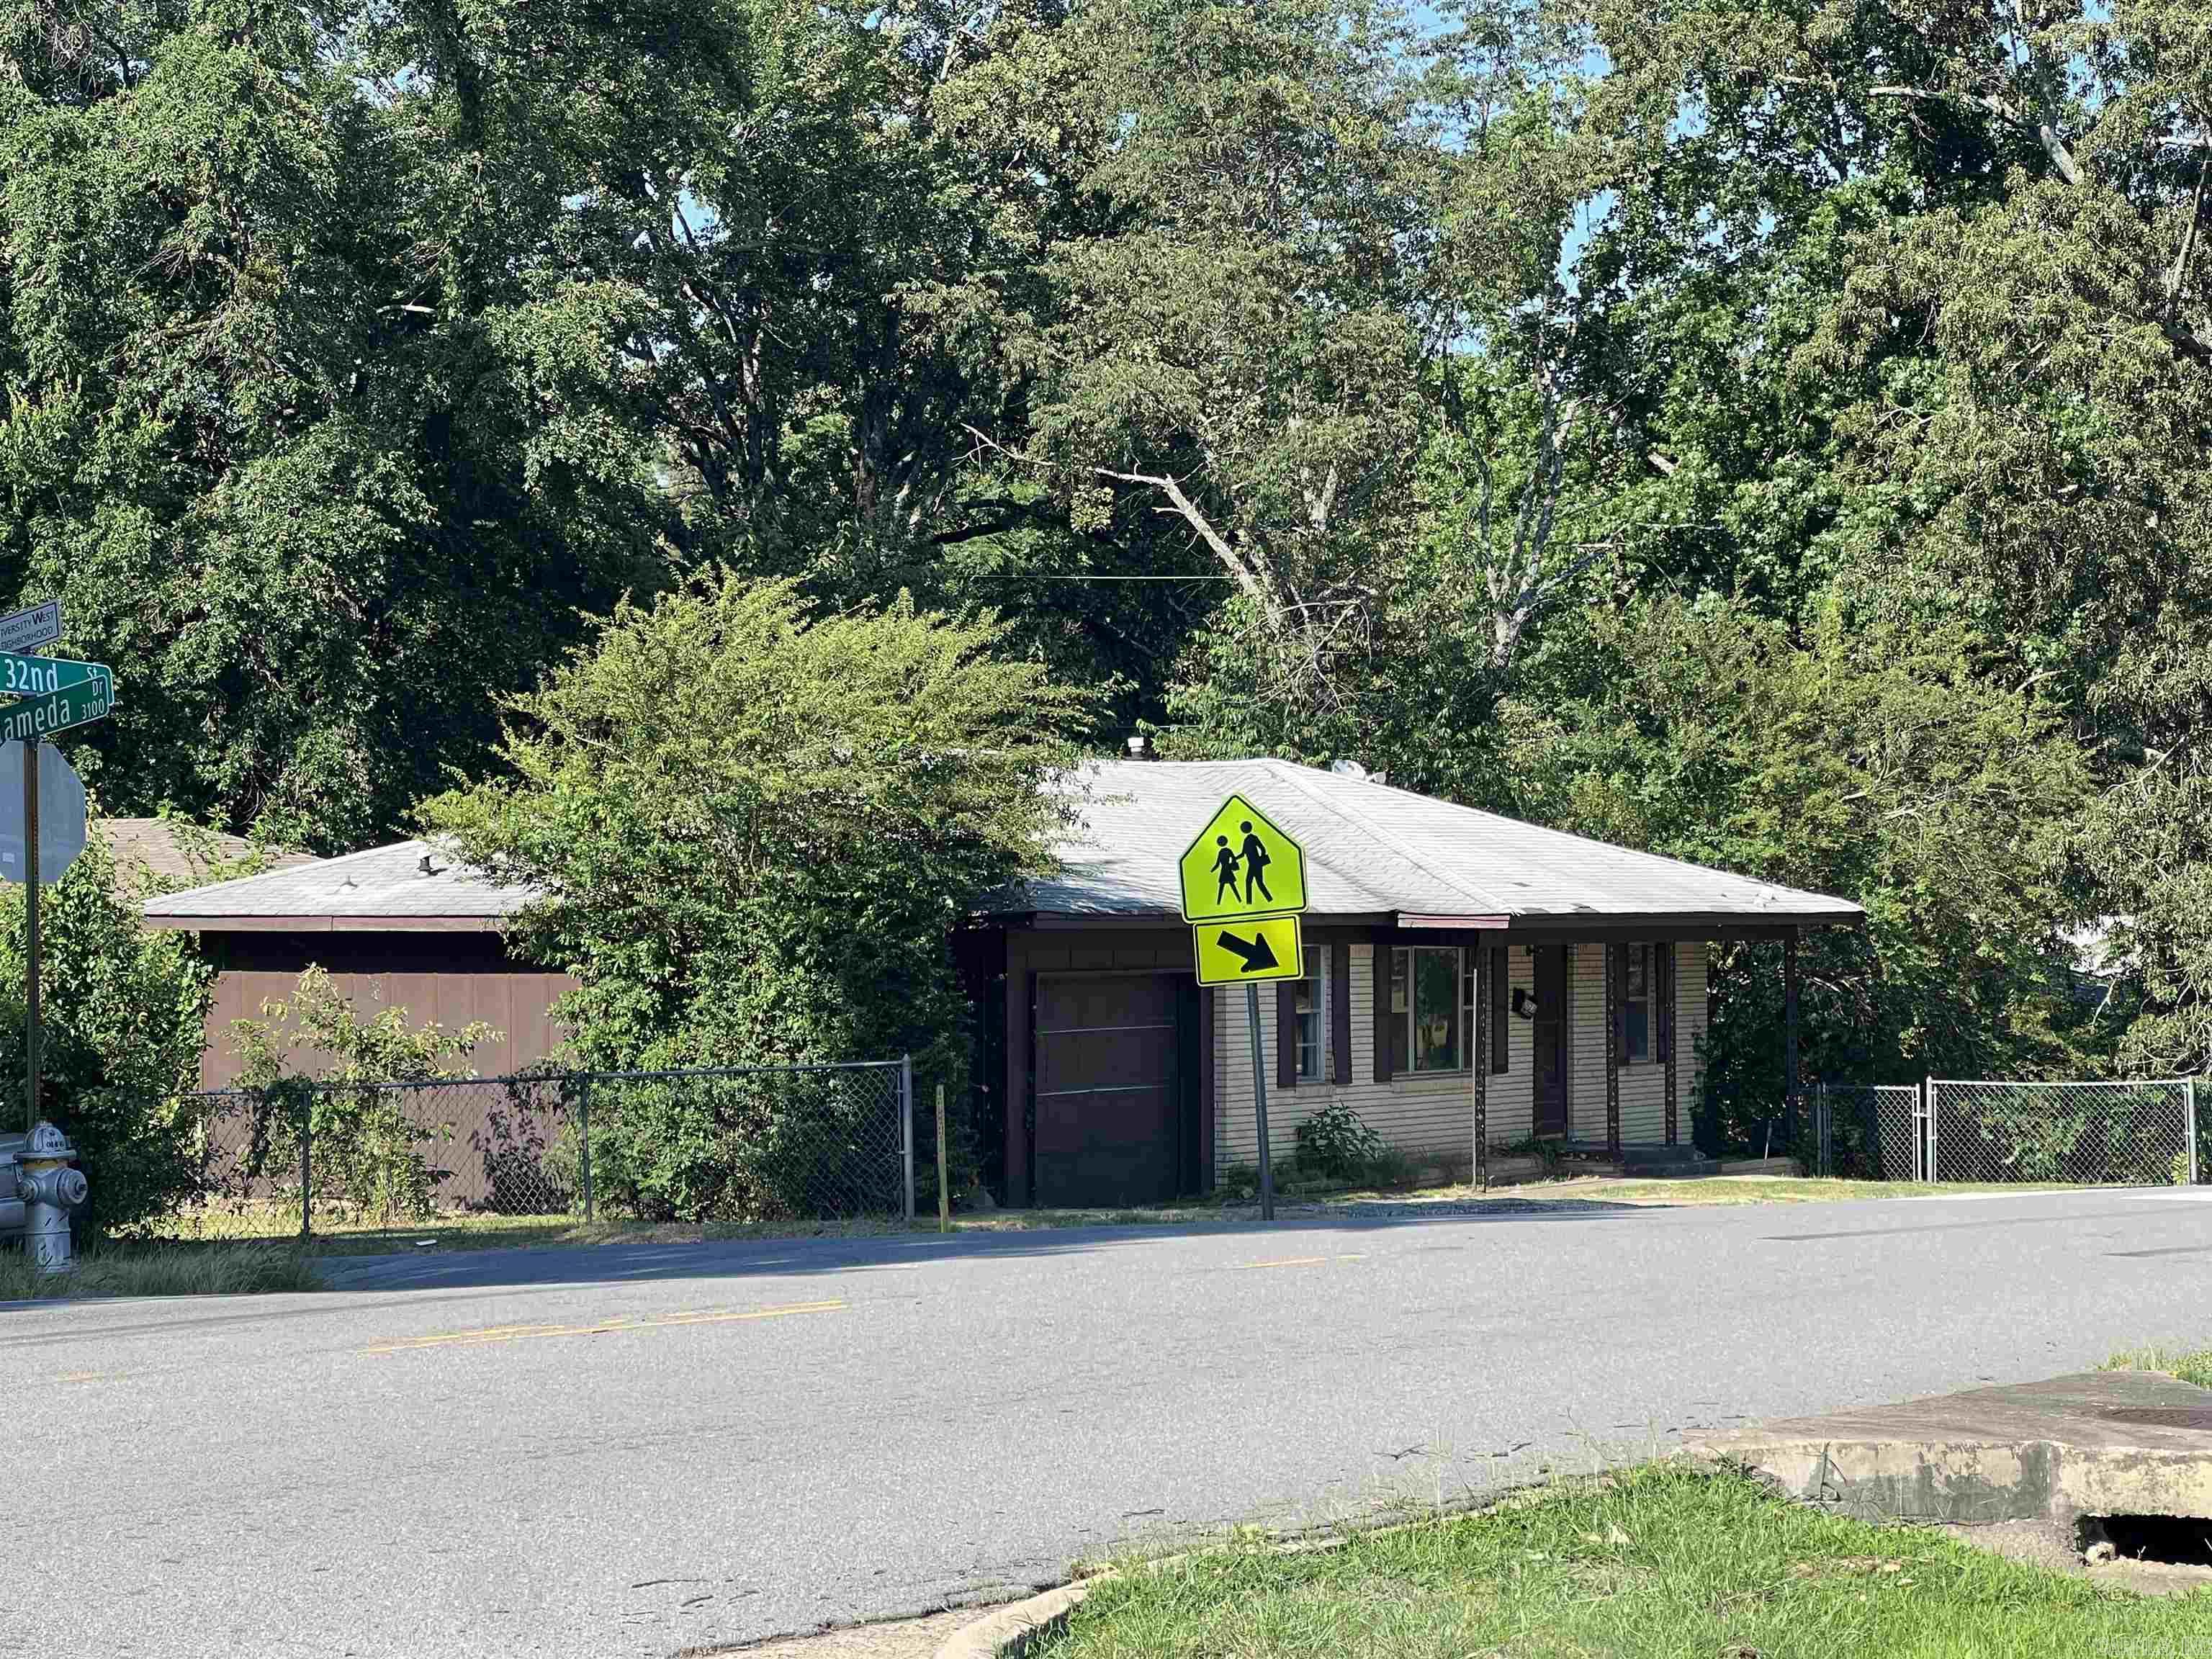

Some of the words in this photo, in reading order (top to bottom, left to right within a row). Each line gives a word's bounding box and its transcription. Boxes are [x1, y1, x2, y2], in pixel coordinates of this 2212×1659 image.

[4, 658, 58, 692] 32nd
[87, 667, 97, 680] St
[92, 680, 103, 696] Dr
[81, 698, 104, 720] 3100
